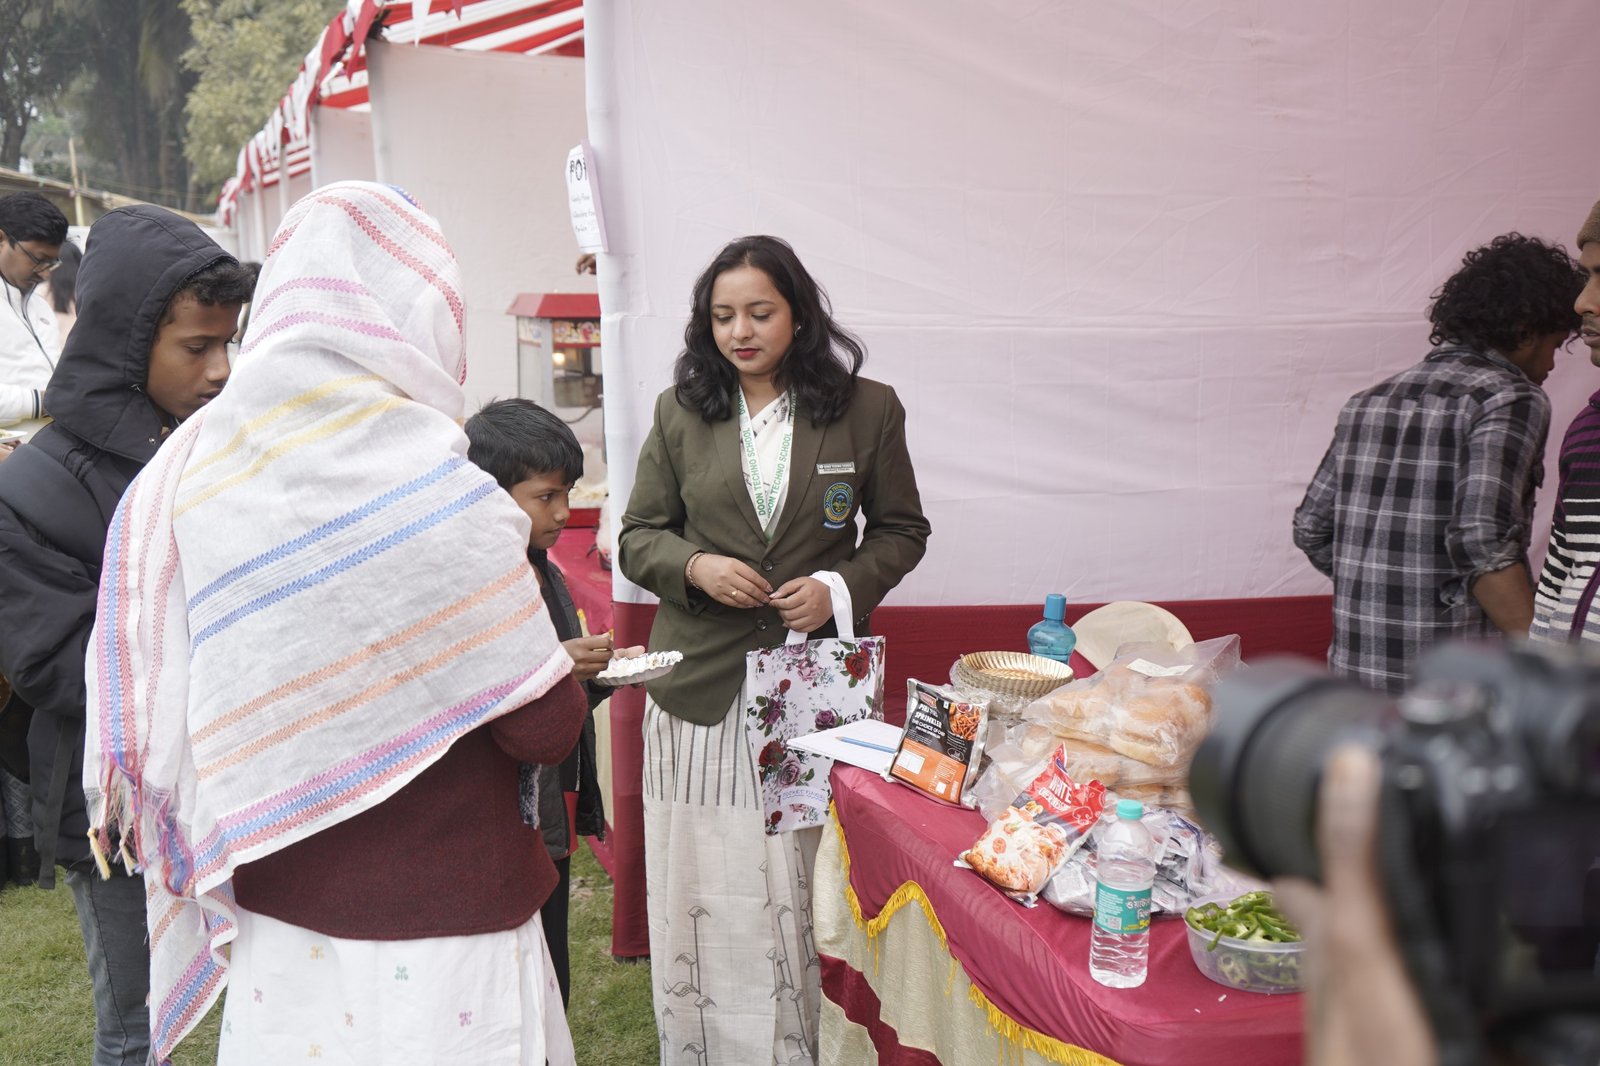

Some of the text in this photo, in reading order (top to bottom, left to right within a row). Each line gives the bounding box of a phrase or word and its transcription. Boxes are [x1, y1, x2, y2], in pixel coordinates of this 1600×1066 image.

[743, 428, 766, 516] DOON TECHNO SCHOOL
[770, 463, 785, 494] TECHNO
[779, 432, 792, 462] SCHOOL
[914, 711, 942, 729] SPRINKLER
